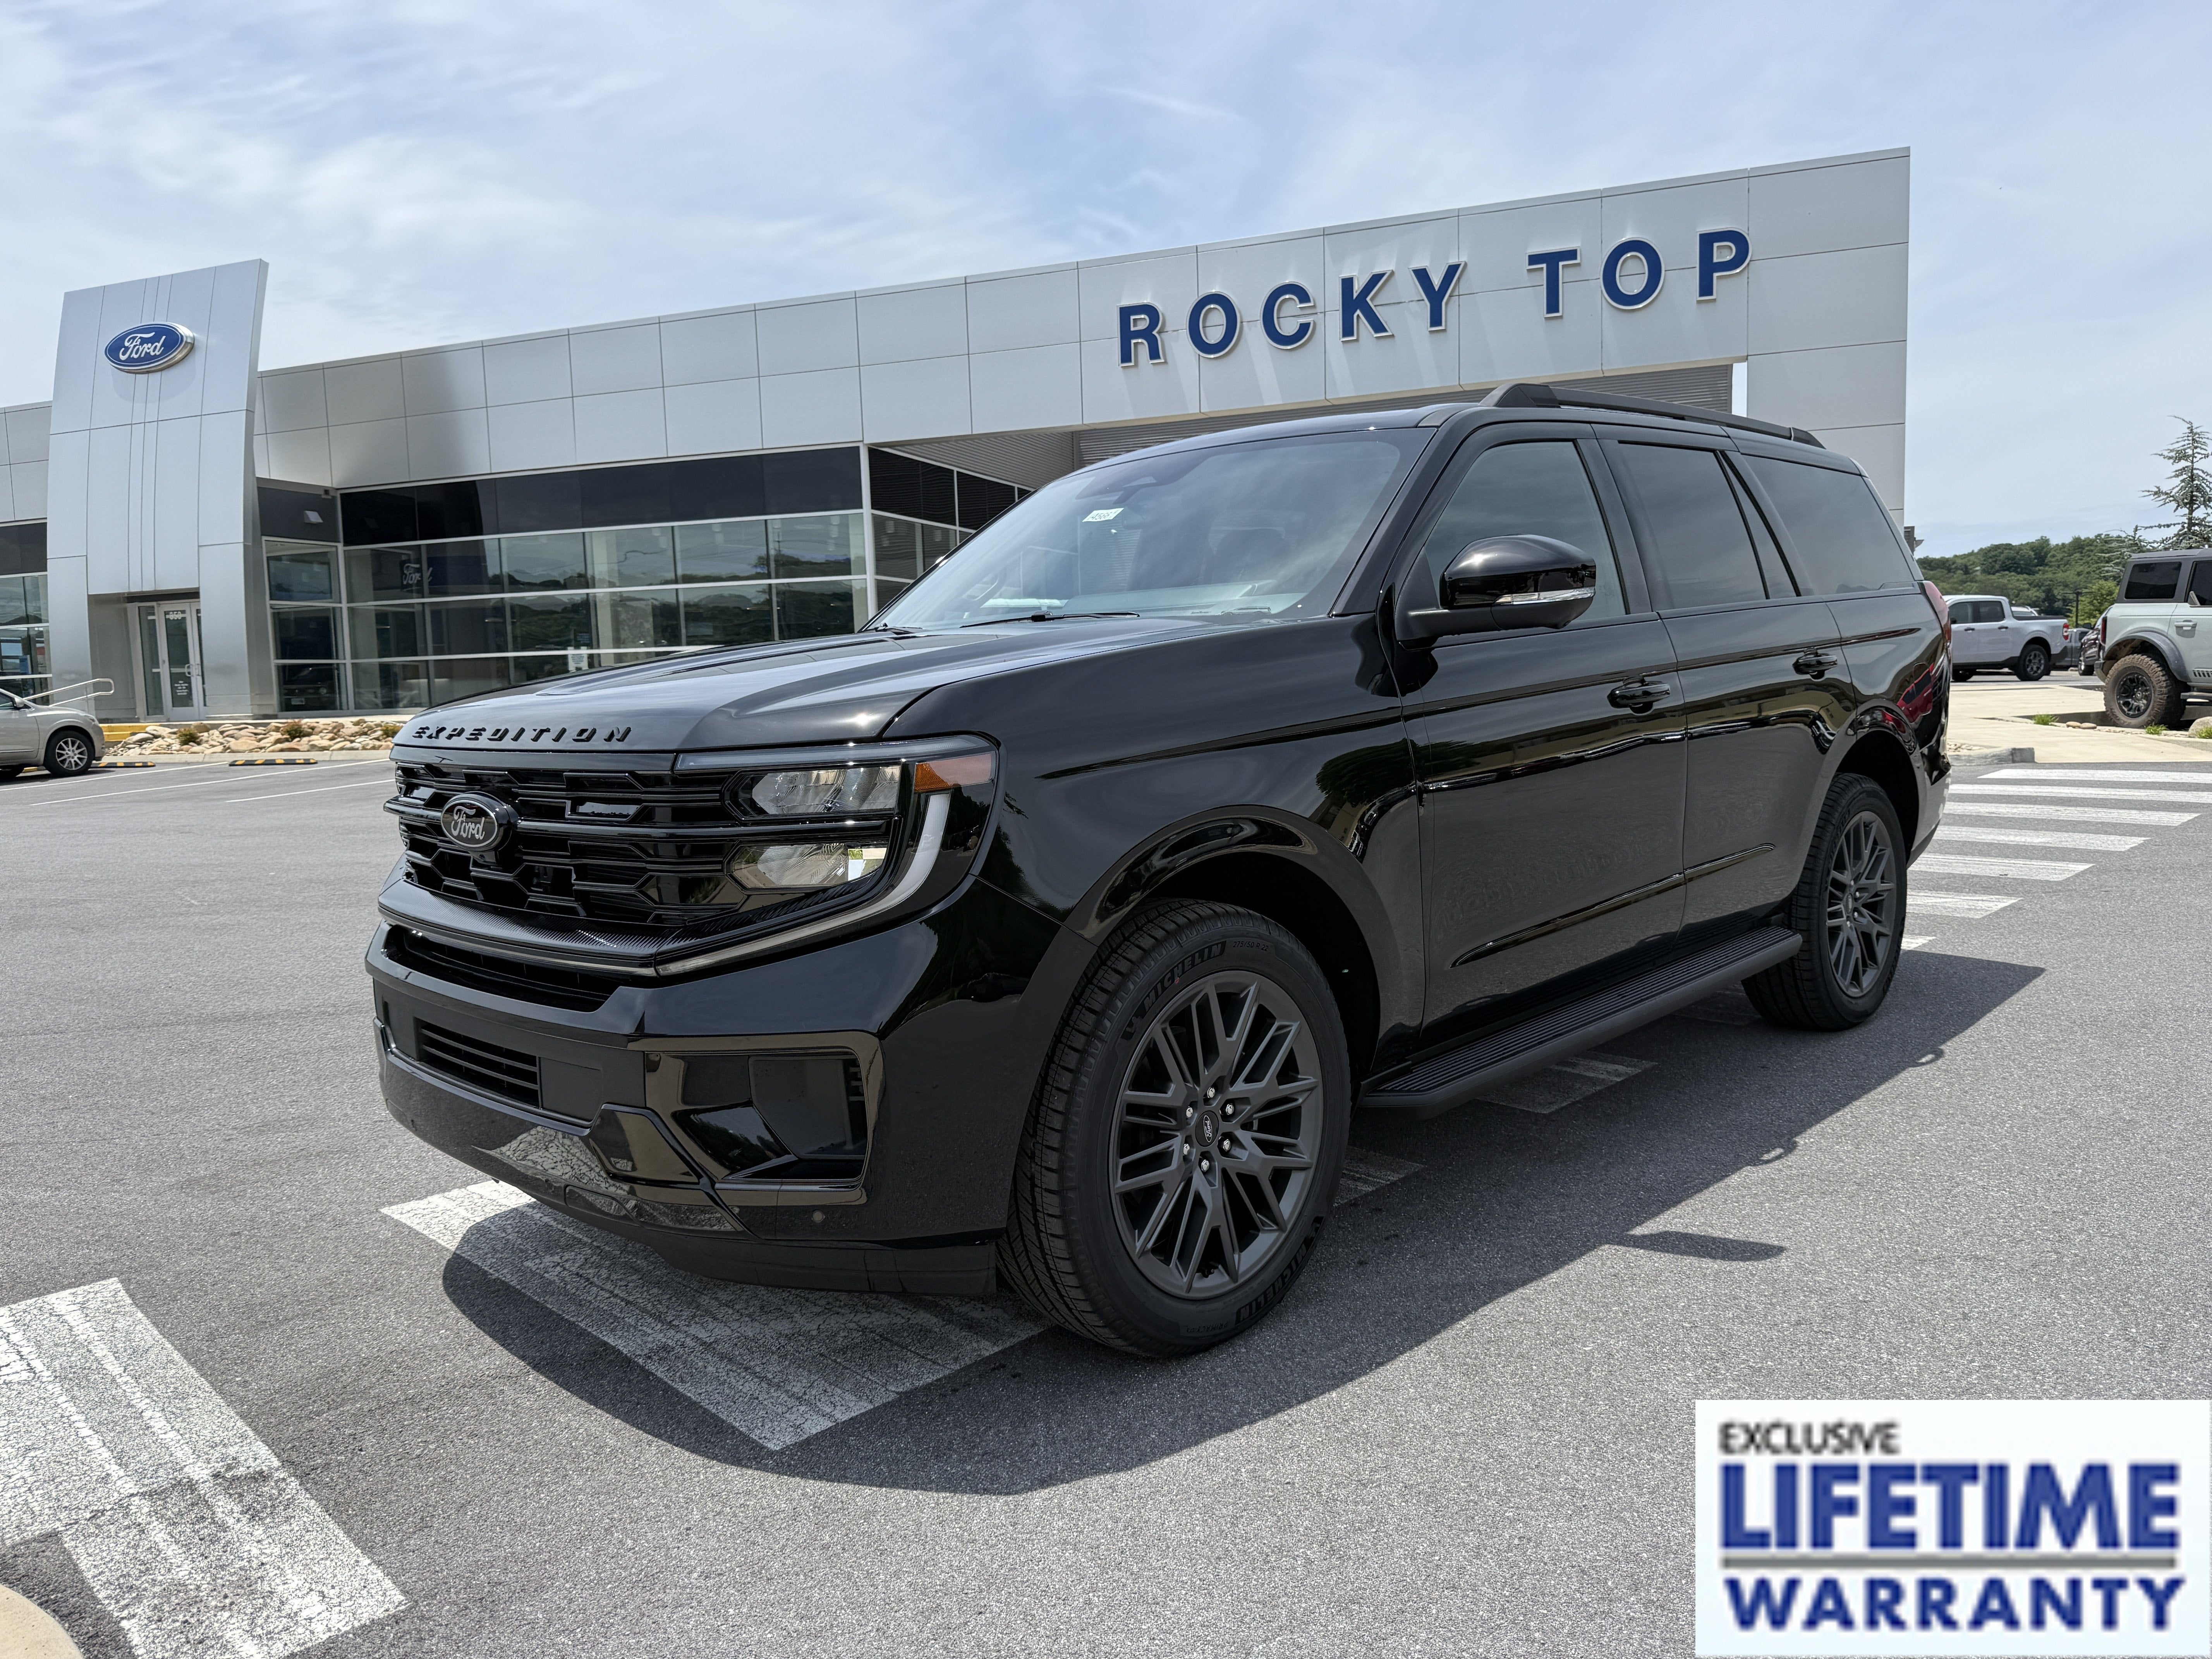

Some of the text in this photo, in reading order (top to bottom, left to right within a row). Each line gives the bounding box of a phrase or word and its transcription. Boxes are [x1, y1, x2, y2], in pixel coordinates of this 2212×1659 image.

[1117, 227, 1752, 366] ROCKY TOP
[119, 332, 166, 361] Ford
[412, 726, 632, 742] EXPEDITION
[451, 806, 485, 840] Ford
[1144, 942, 1223, 1012] MICHELIN
[1239, 1243, 1307, 1320] MICHELIN
